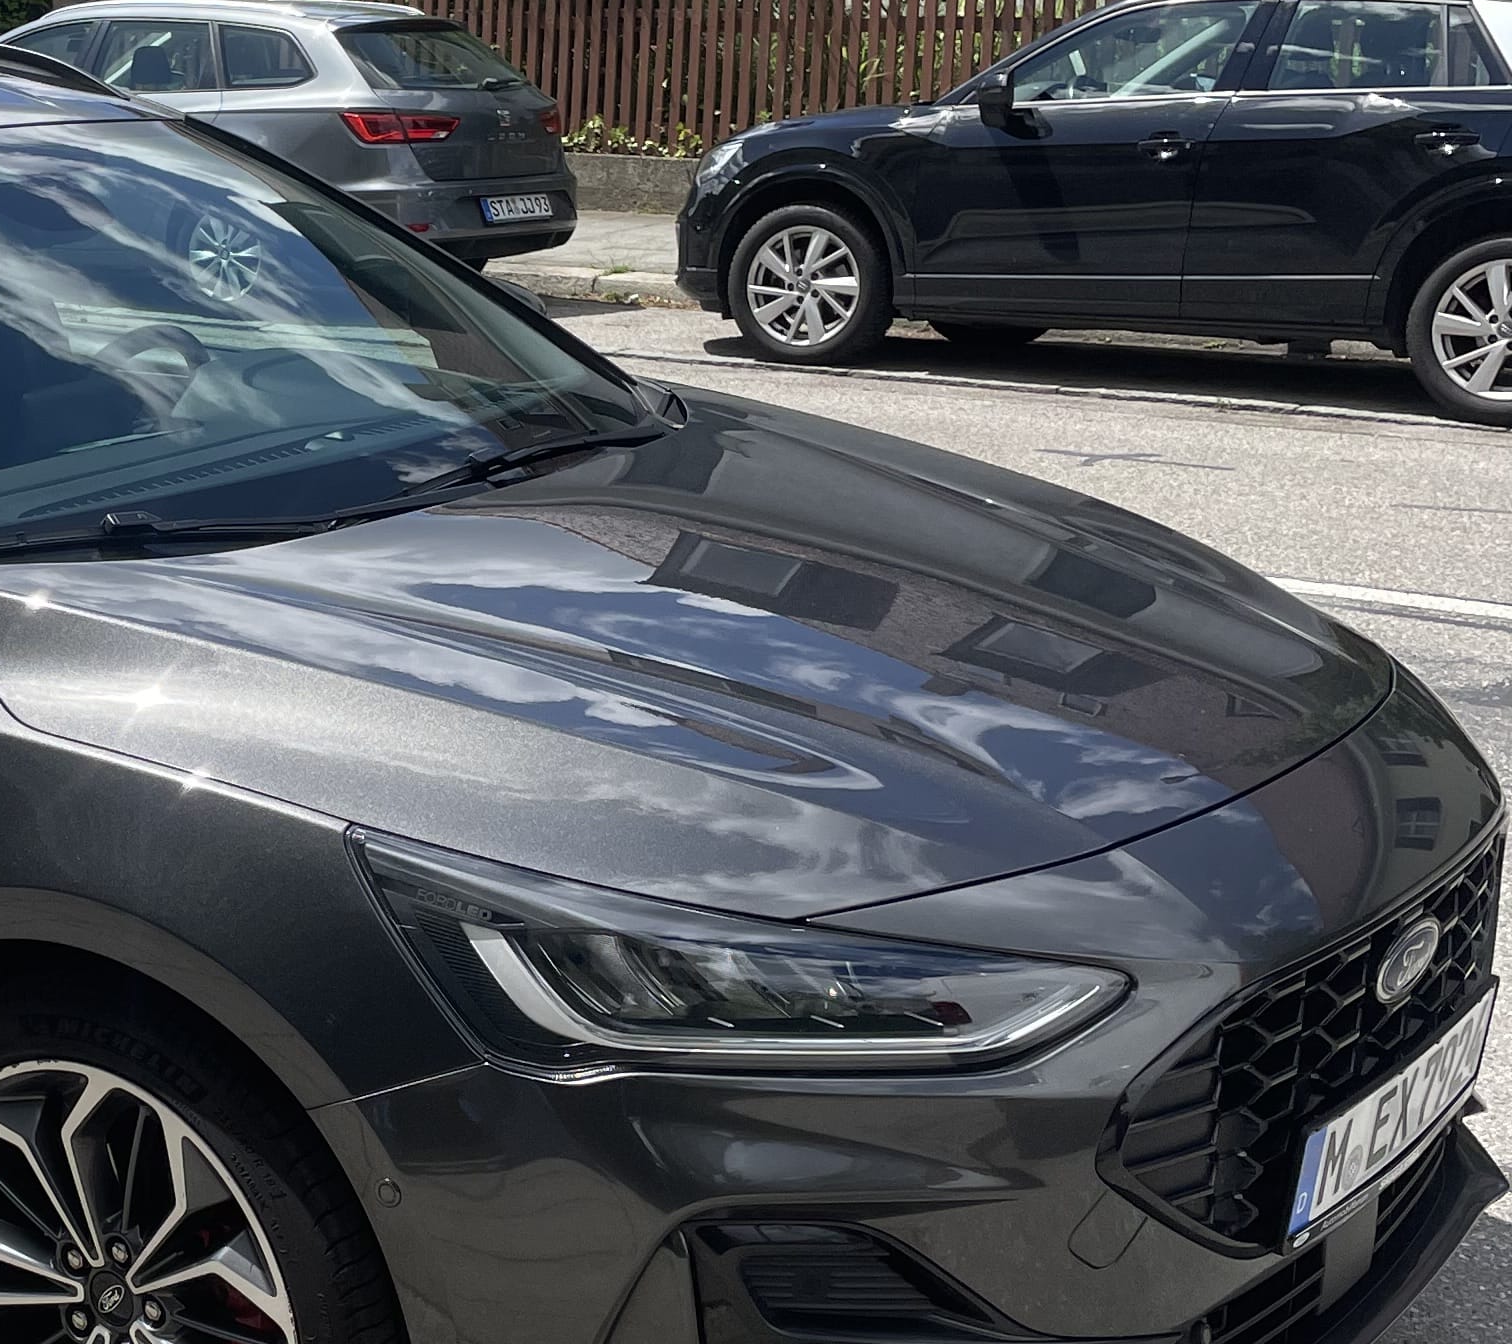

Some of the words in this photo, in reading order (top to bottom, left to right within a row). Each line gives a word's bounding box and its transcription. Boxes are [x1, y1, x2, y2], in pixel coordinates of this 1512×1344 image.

[490, 200, 514, 217] STA
[1317, 1118, 1353, 1206] M
[1364, 1067, 1420, 1170] EX
[1296, 1192, 1308, 1214] D
